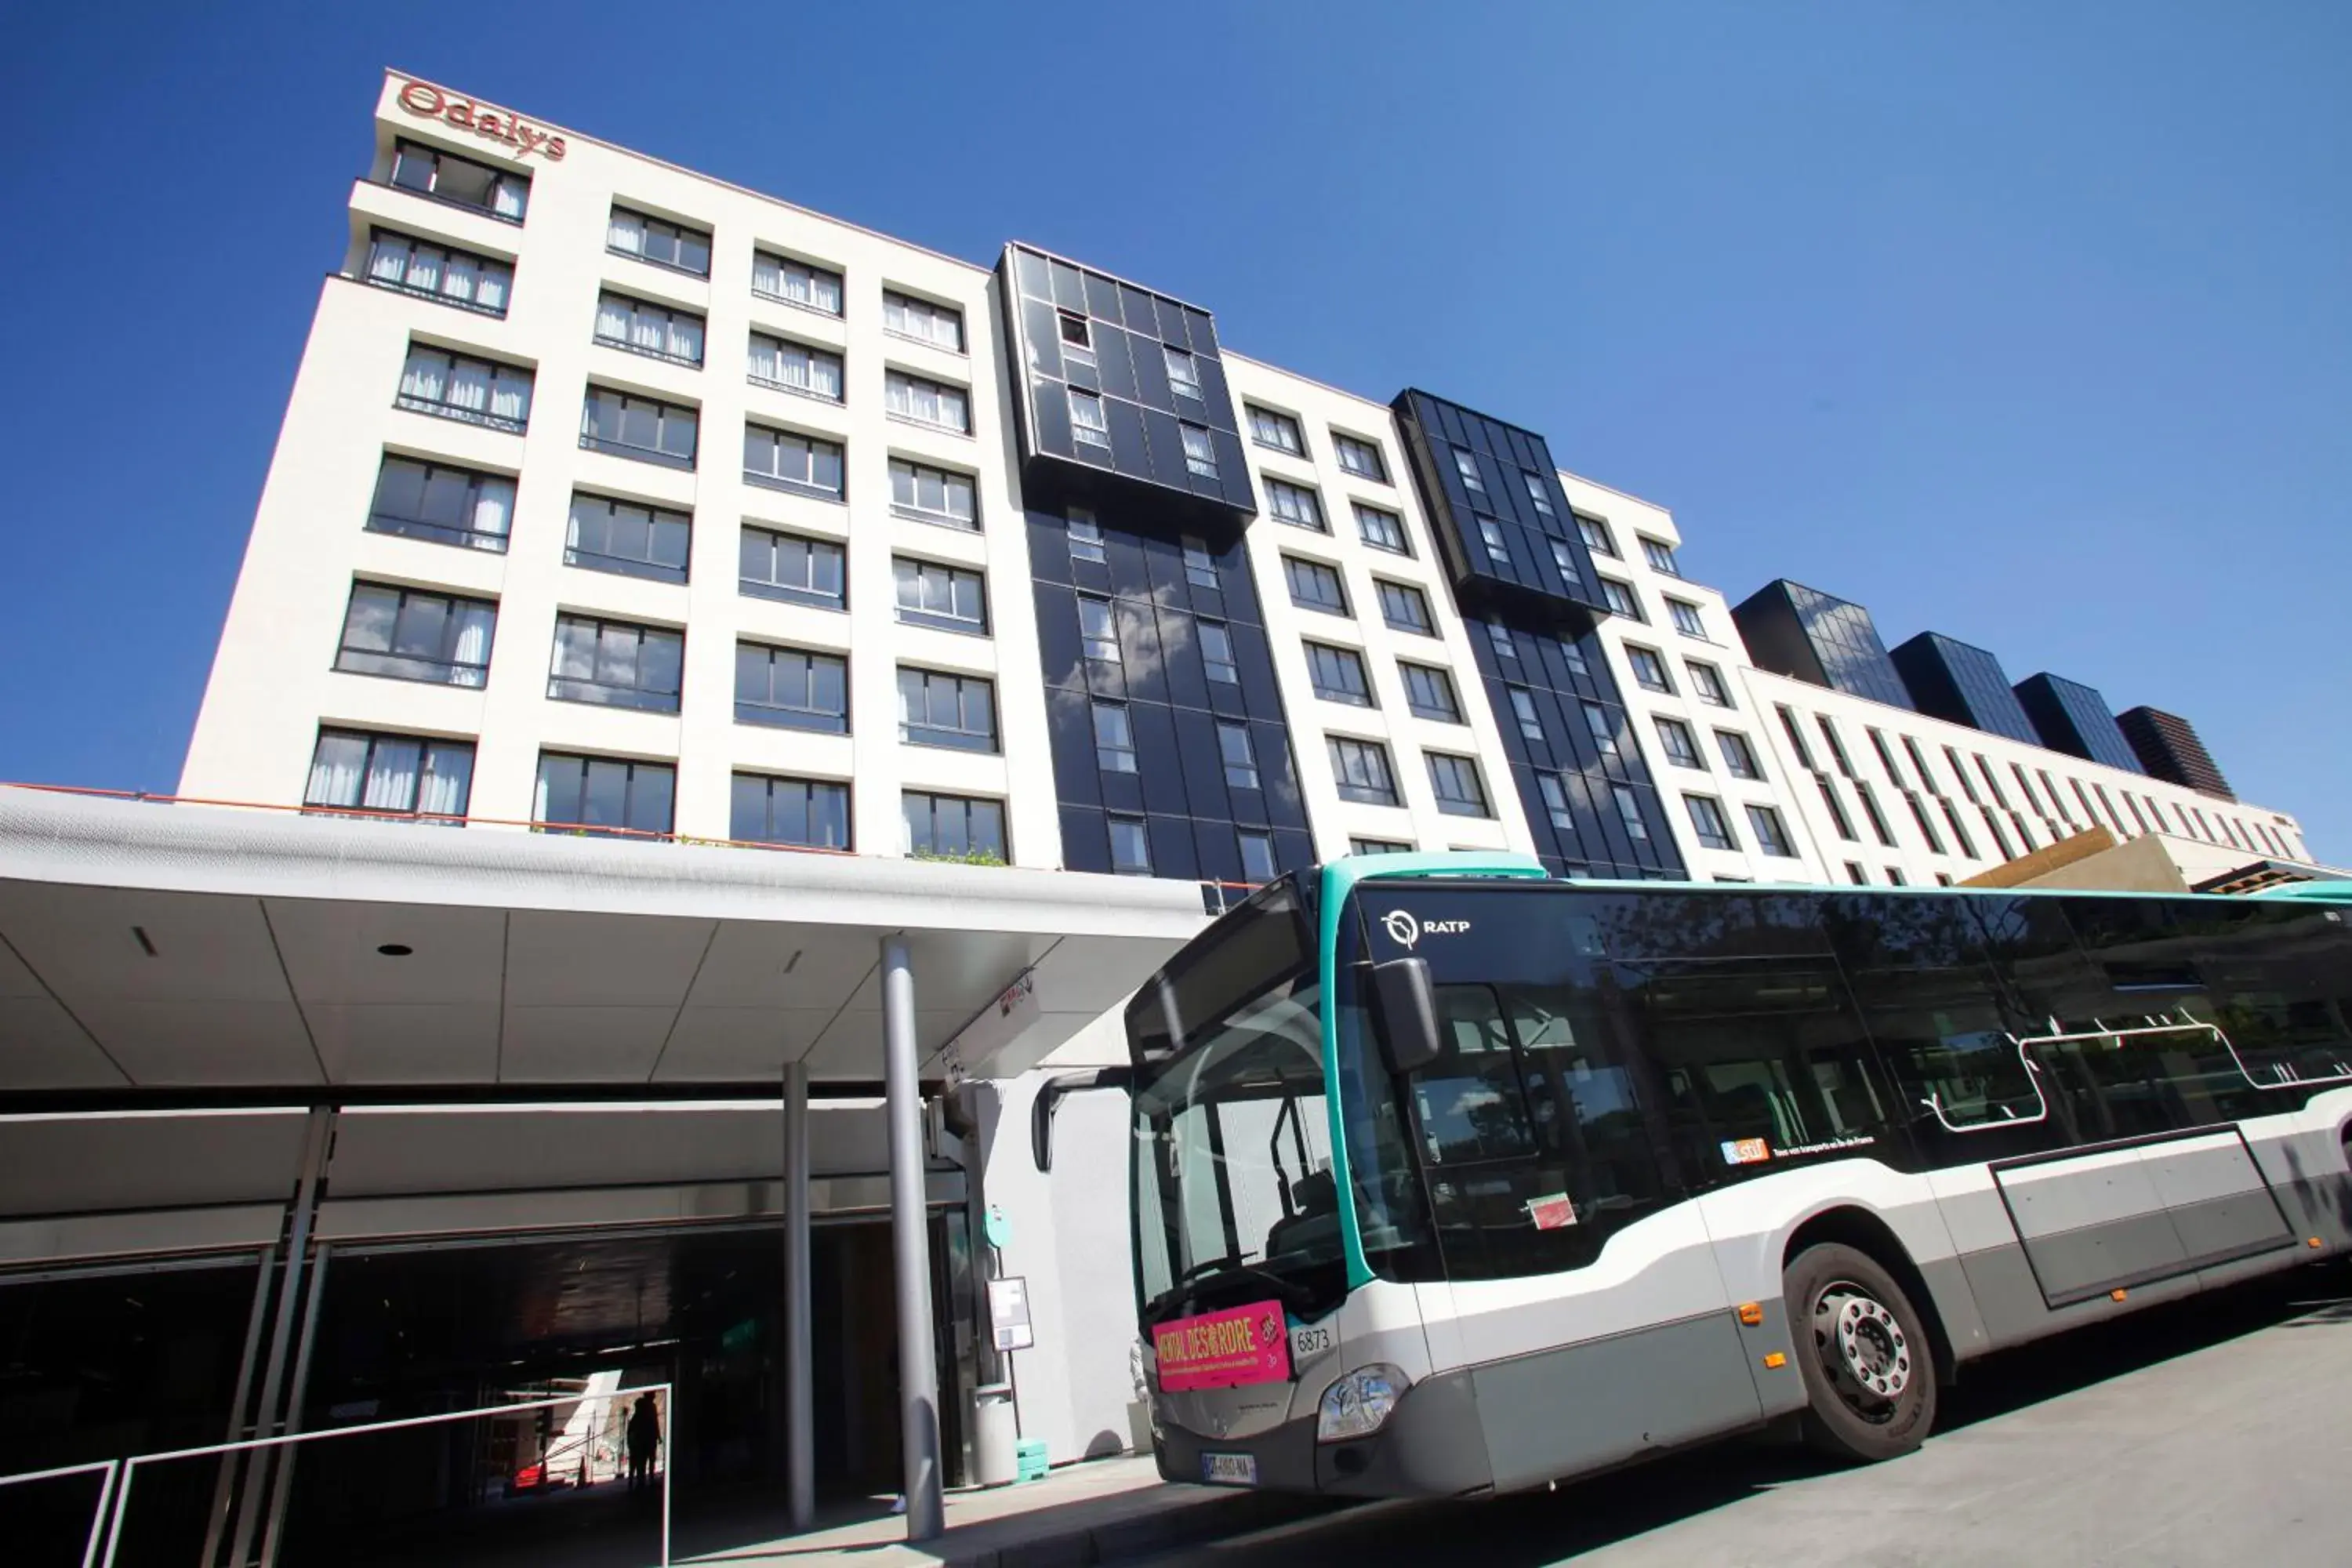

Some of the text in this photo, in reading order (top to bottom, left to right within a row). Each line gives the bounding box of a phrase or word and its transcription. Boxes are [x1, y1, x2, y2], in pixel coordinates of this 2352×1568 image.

[401, 81, 565, 160] Odalys
[1424, 921, 1470, 932] RATP
[1298, 1328, 1330, 1352] 6873
